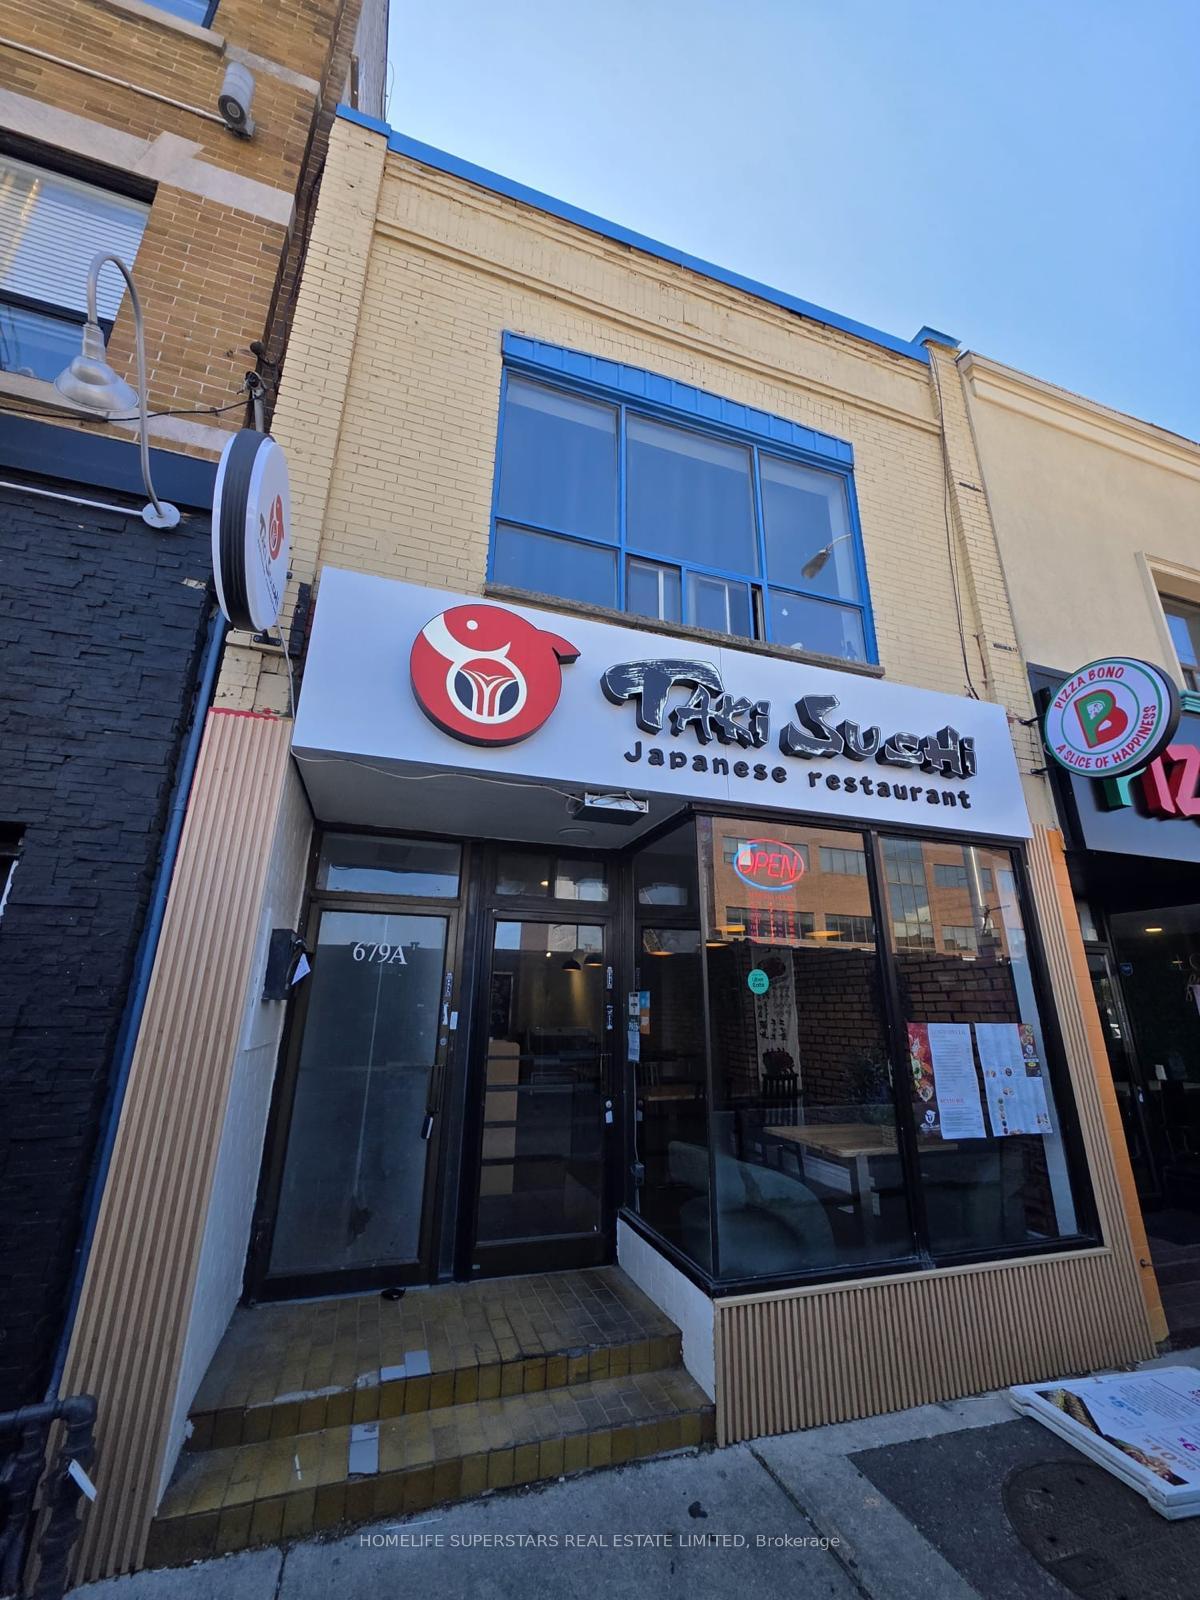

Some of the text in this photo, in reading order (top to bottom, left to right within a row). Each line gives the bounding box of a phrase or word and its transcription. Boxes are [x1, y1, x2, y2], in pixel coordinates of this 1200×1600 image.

[1054, 666, 1125, 709] PIZZA BONO
[1055, 704, 1158, 769] A SLICE OF HAPPINESS
[623, 740, 972, 810] Japanese restaurant
[737, 850, 798, 878] OPEN
[352, 941, 408, 965] 679A
